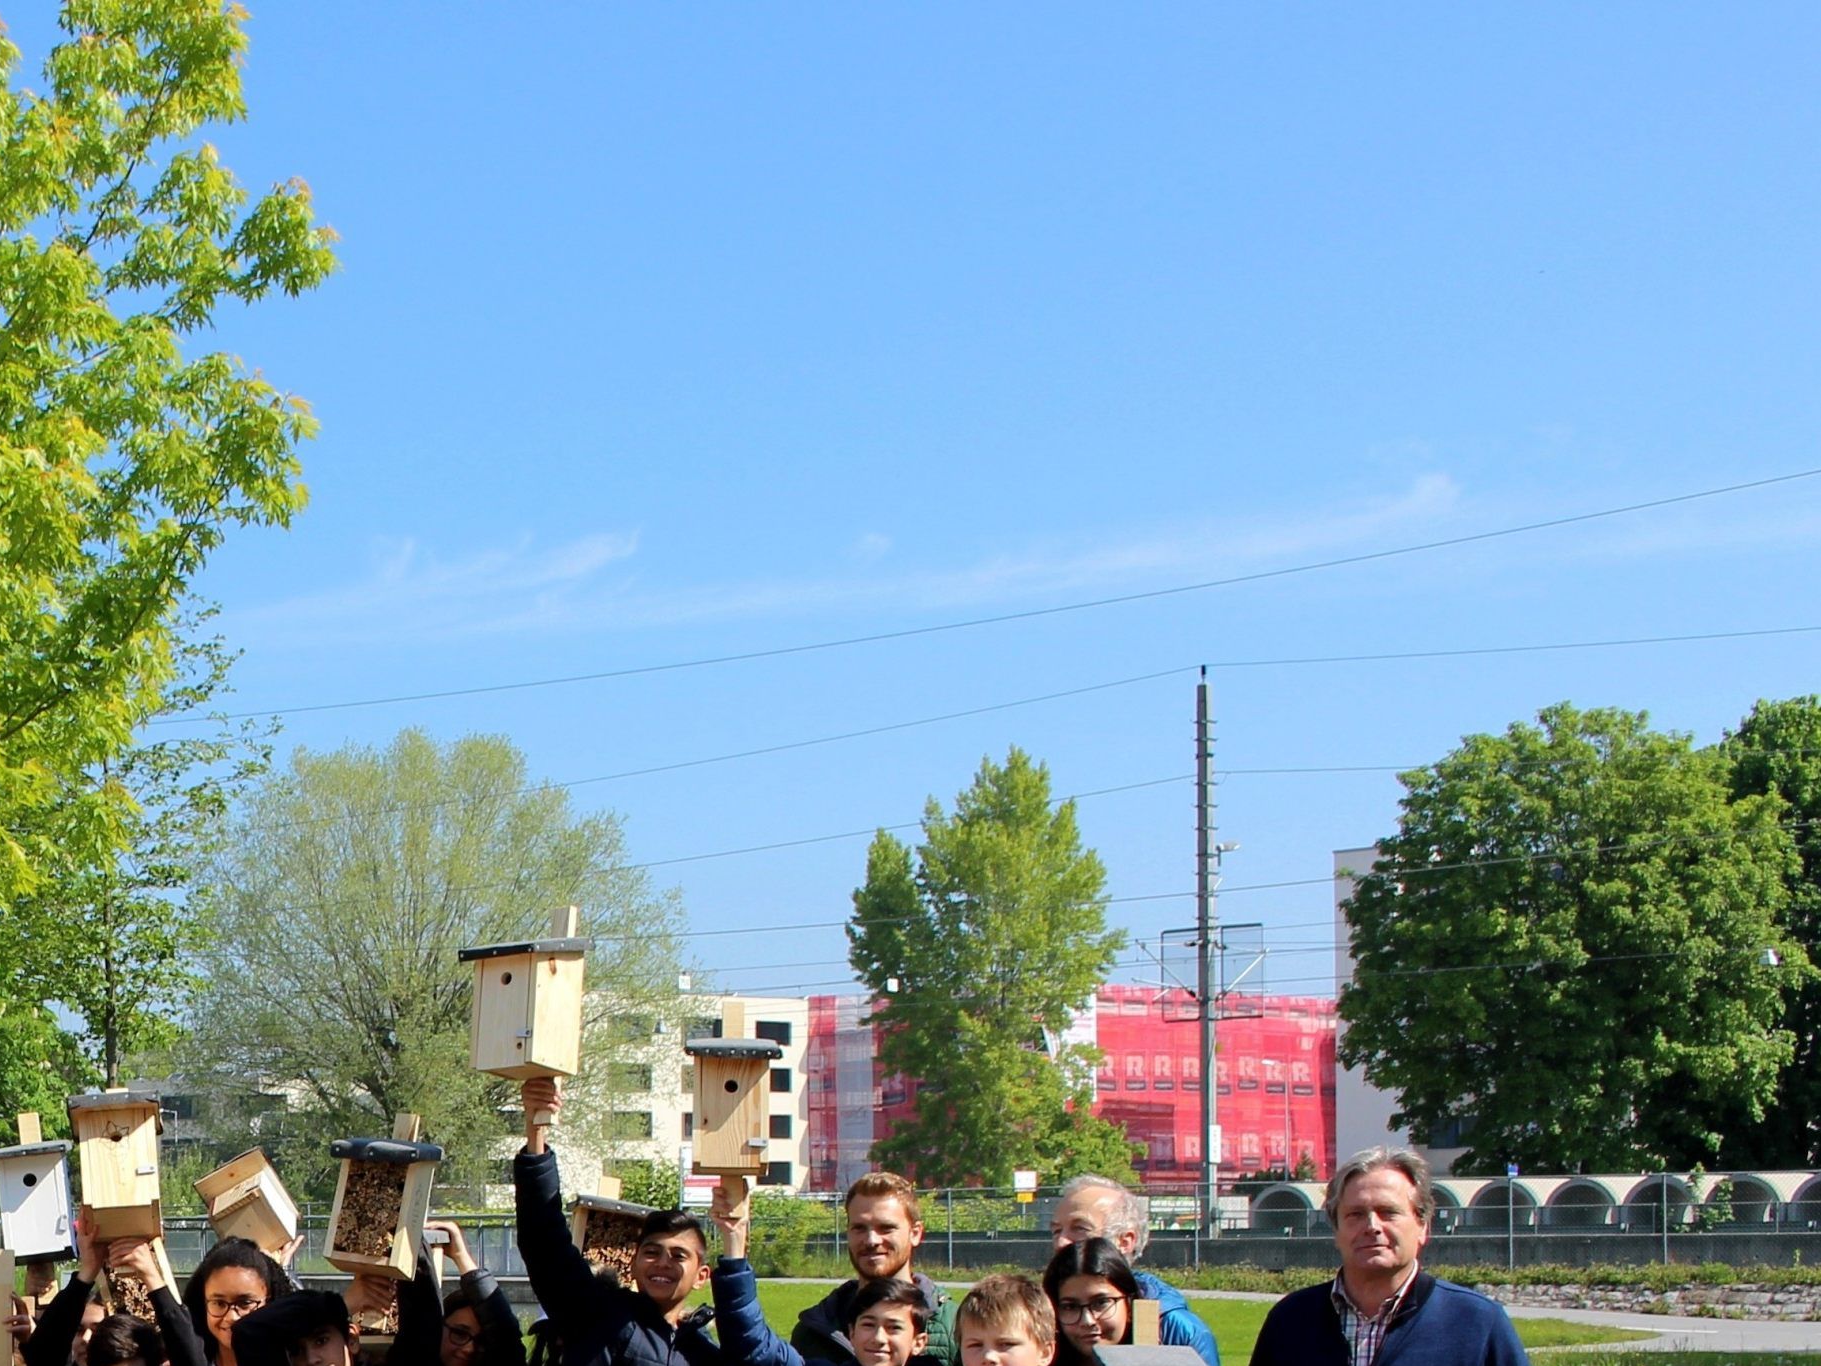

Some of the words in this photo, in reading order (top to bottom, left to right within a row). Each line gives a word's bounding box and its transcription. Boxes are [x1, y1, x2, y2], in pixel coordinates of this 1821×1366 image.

[1126, 1055, 1144, 1077] R
[1154, 1055, 1172, 1077] R
[1239, 1056, 1256, 1077] R
[1292, 1061, 1310, 1082] R
